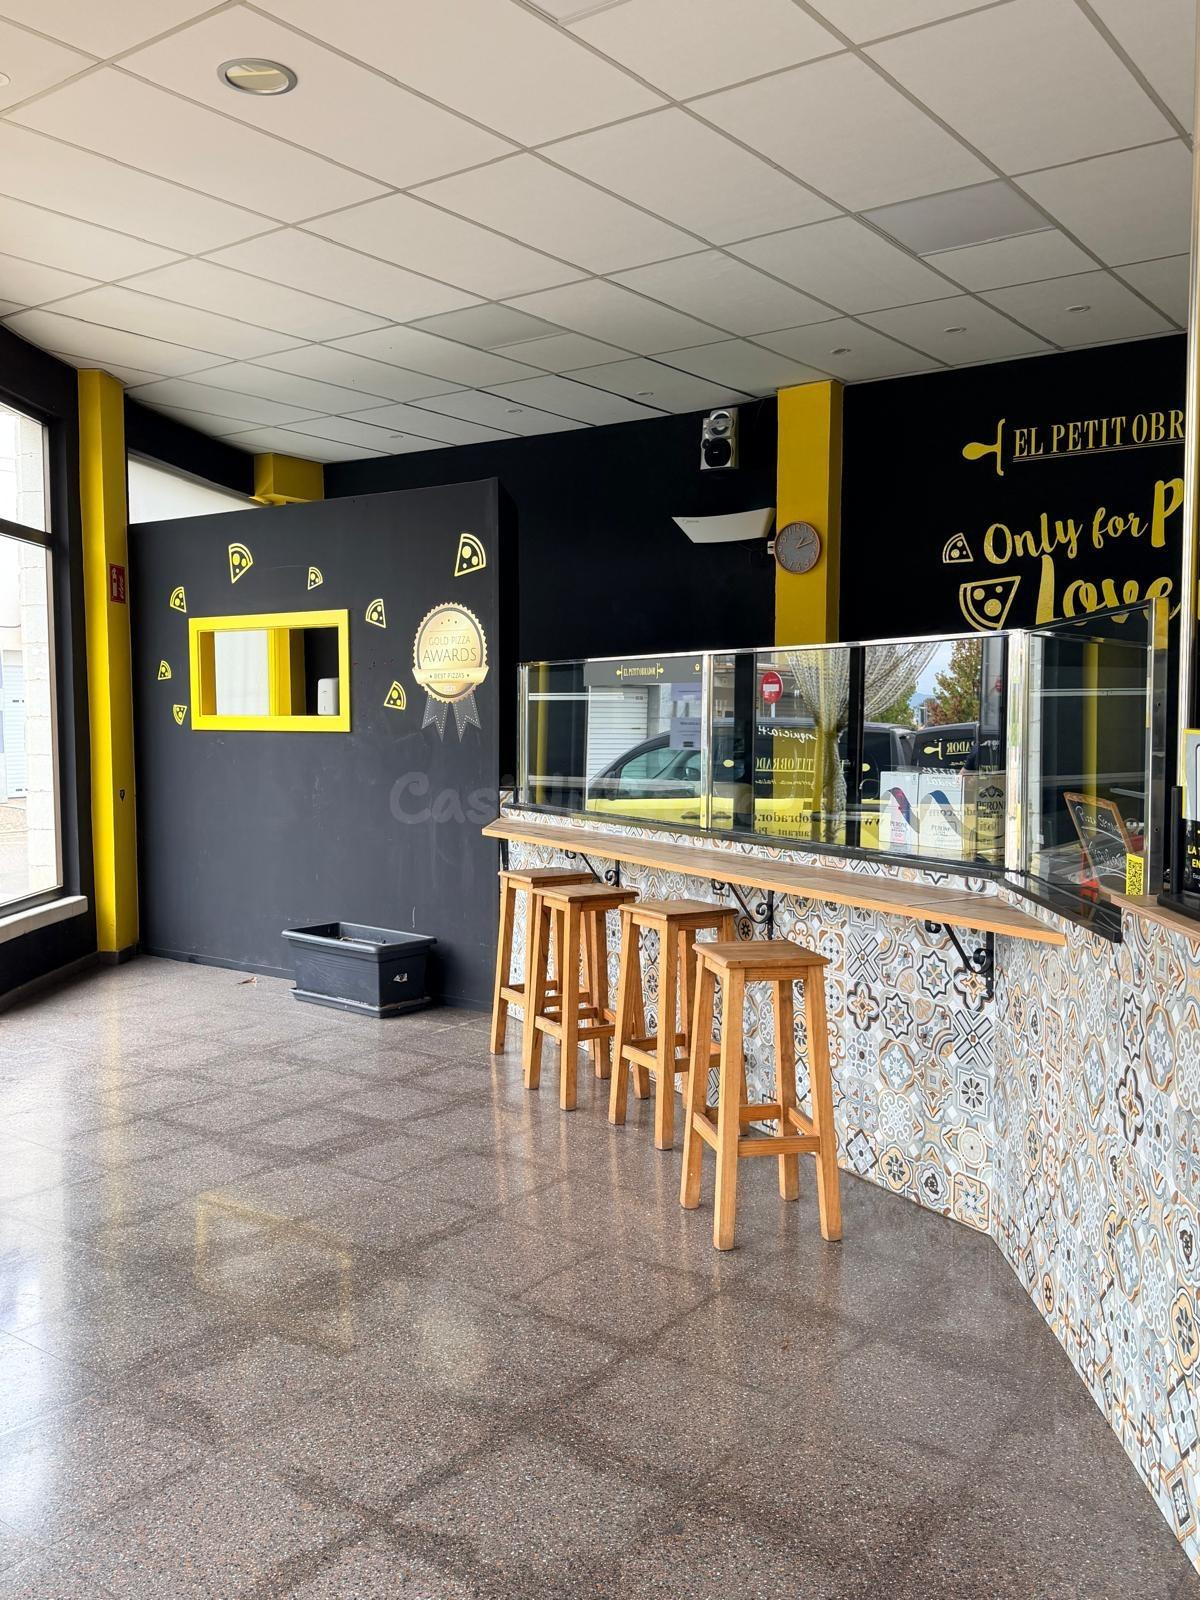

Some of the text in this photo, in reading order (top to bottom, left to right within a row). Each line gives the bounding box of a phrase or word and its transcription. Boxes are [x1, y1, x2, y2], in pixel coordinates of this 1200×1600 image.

[1013, 409, 1185, 458] EL PETIT OBR
[983, 477, 1185, 565] Only for P
[422, 647, 477, 662] AWARDS
[451, 635, 471, 645] PIZZA
